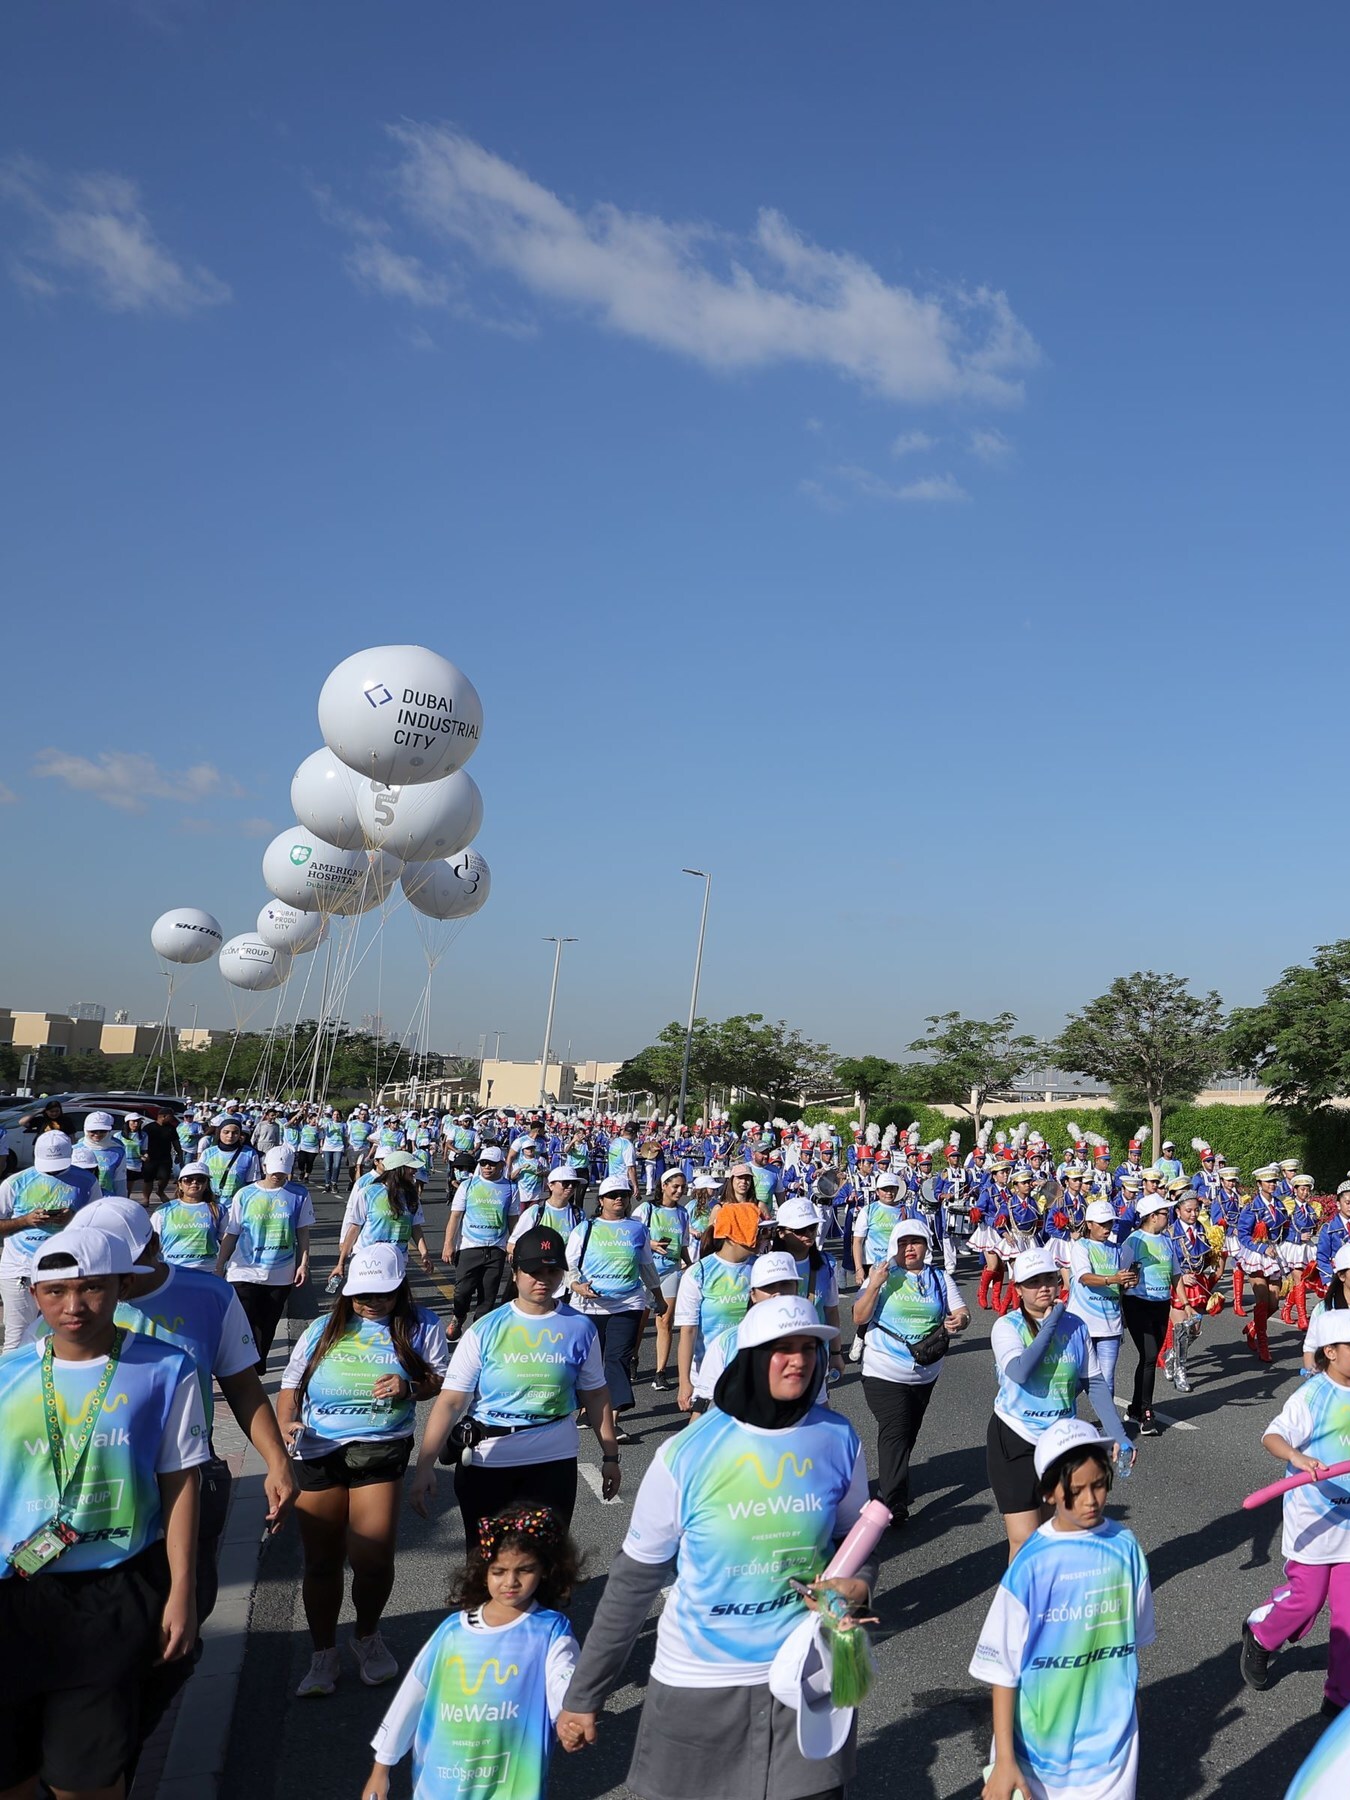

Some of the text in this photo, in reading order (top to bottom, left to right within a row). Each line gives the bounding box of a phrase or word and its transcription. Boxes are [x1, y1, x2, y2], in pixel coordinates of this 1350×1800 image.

[402, 688, 453, 713] DUBAI
[397, 709, 479, 740] INDUSTRIAL
[393, 729, 436, 750] CITY
[309, 862, 364, 877] AMERICAN
[307, 870, 357, 885] HOSPITAL
[173, 1222, 211, 1230] WeWalk
[599, 1239, 633, 1247] WeWalk
[893, 1293, 934, 1304] WeWalk
[331, 1352, 399, 1365] WeWalk
[504, 1352, 566, 1364] WeWalk
[1043, 1353, 1076, 1364] eWalk
[527, 1390, 555, 1399] GROUP
[70, 1491, 111, 1506] GROUP
[727, 1494, 823, 1520] WeWalk
[752, 1532, 790, 1541] PRESENTED
[771, 1557, 807, 1573] GROUP
[1060, 1567, 1112, 1582] PRESENTED BY
[1084, 1598, 1123, 1619] GROUP
[440, 1701, 520, 1723] WeWalk
[458, 1764, 500, 1781] GROUP
